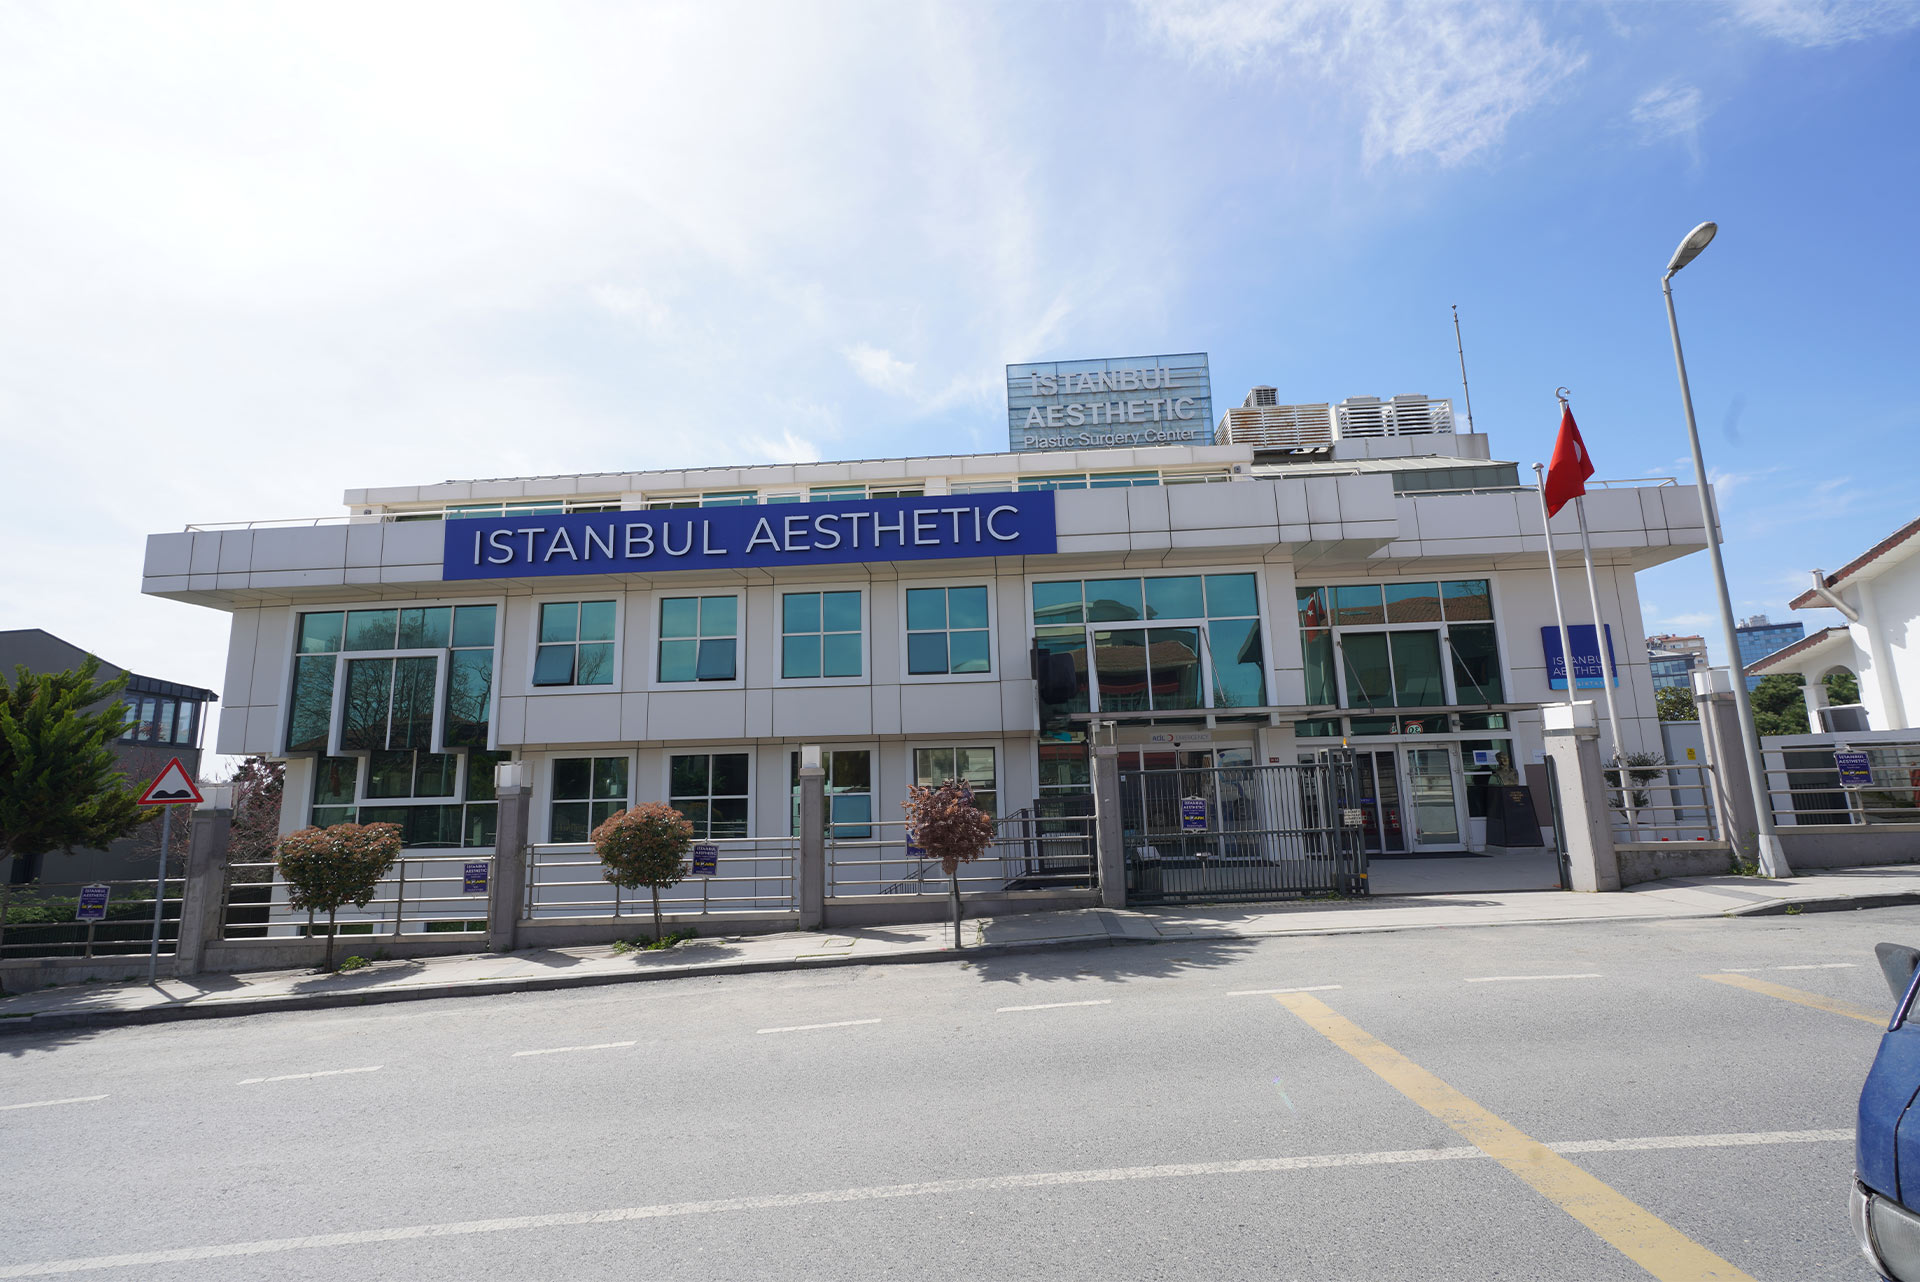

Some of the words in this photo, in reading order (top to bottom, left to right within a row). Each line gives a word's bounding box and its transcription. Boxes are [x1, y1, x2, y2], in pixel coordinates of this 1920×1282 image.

[1023, 396, 1195, 429] AESTHETIC
[1023, 435, 1074, 449] Plastic
[1078, 432, 1140, 447] Surgery
[1144, 429, 1196, 443] Center
[474, 519, 728, 565] ISTANBUL
[745, 505, 1020, 553] AESTHETIC
[1553, 655, 1603, 665] ISANBU
